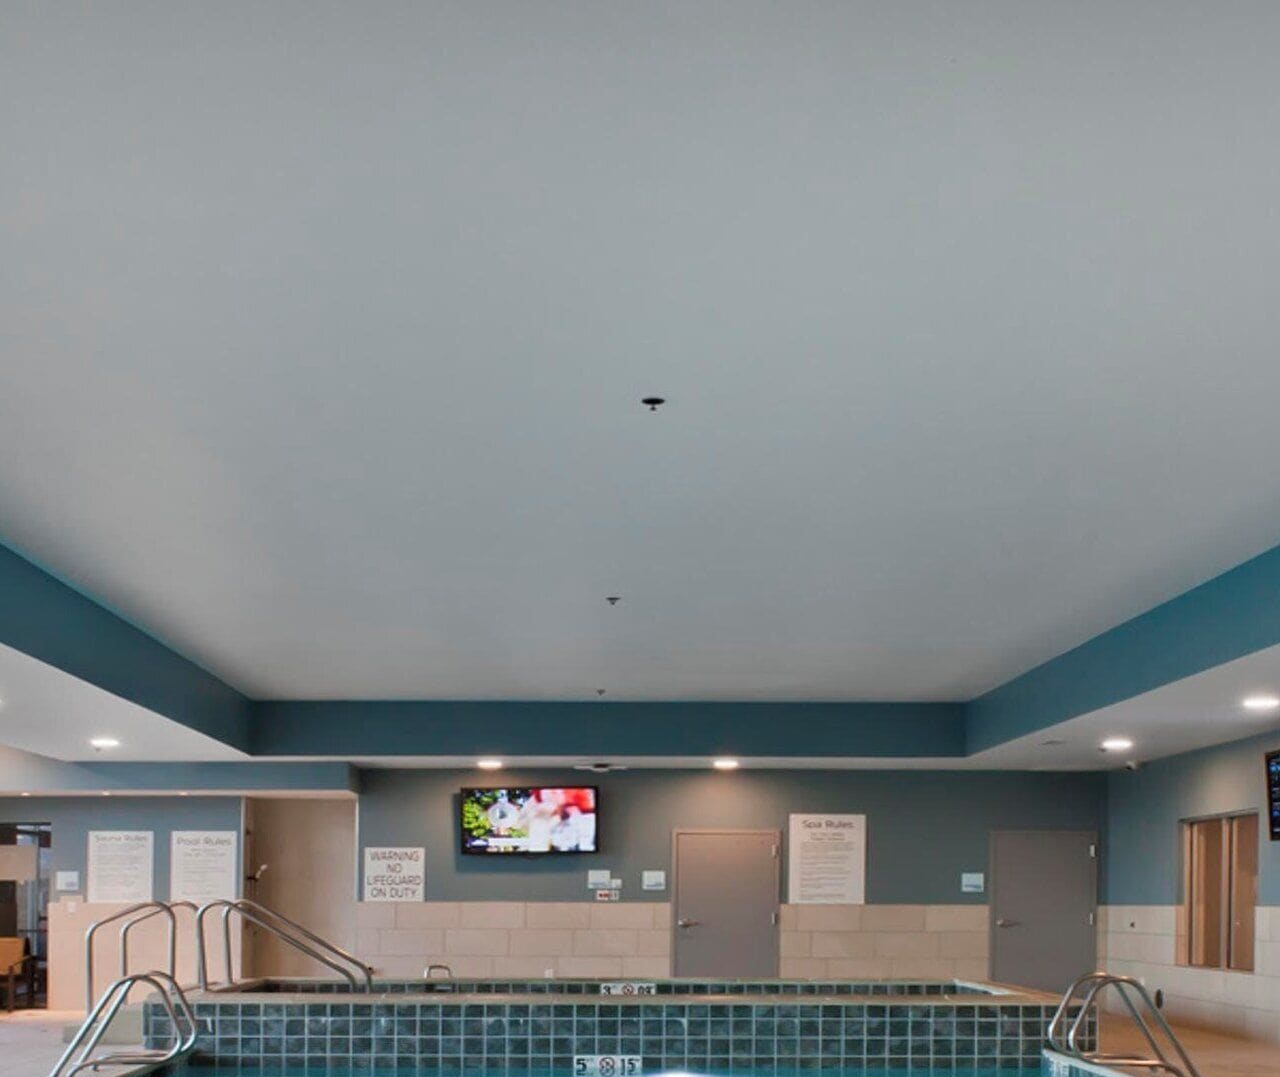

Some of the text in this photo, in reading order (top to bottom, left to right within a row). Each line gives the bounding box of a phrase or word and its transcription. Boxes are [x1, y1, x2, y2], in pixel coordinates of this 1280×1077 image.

[801, 820, 855, 829] Spa Rules
[176, 836, 232, 846] Pool Rules
[369, 850, 421, 862] WARNING
[386, 863, 402, 874] NO
[367, 875, 422, 886] LIFEGUARD
[371, 887, 419, 898] ON DUTY
